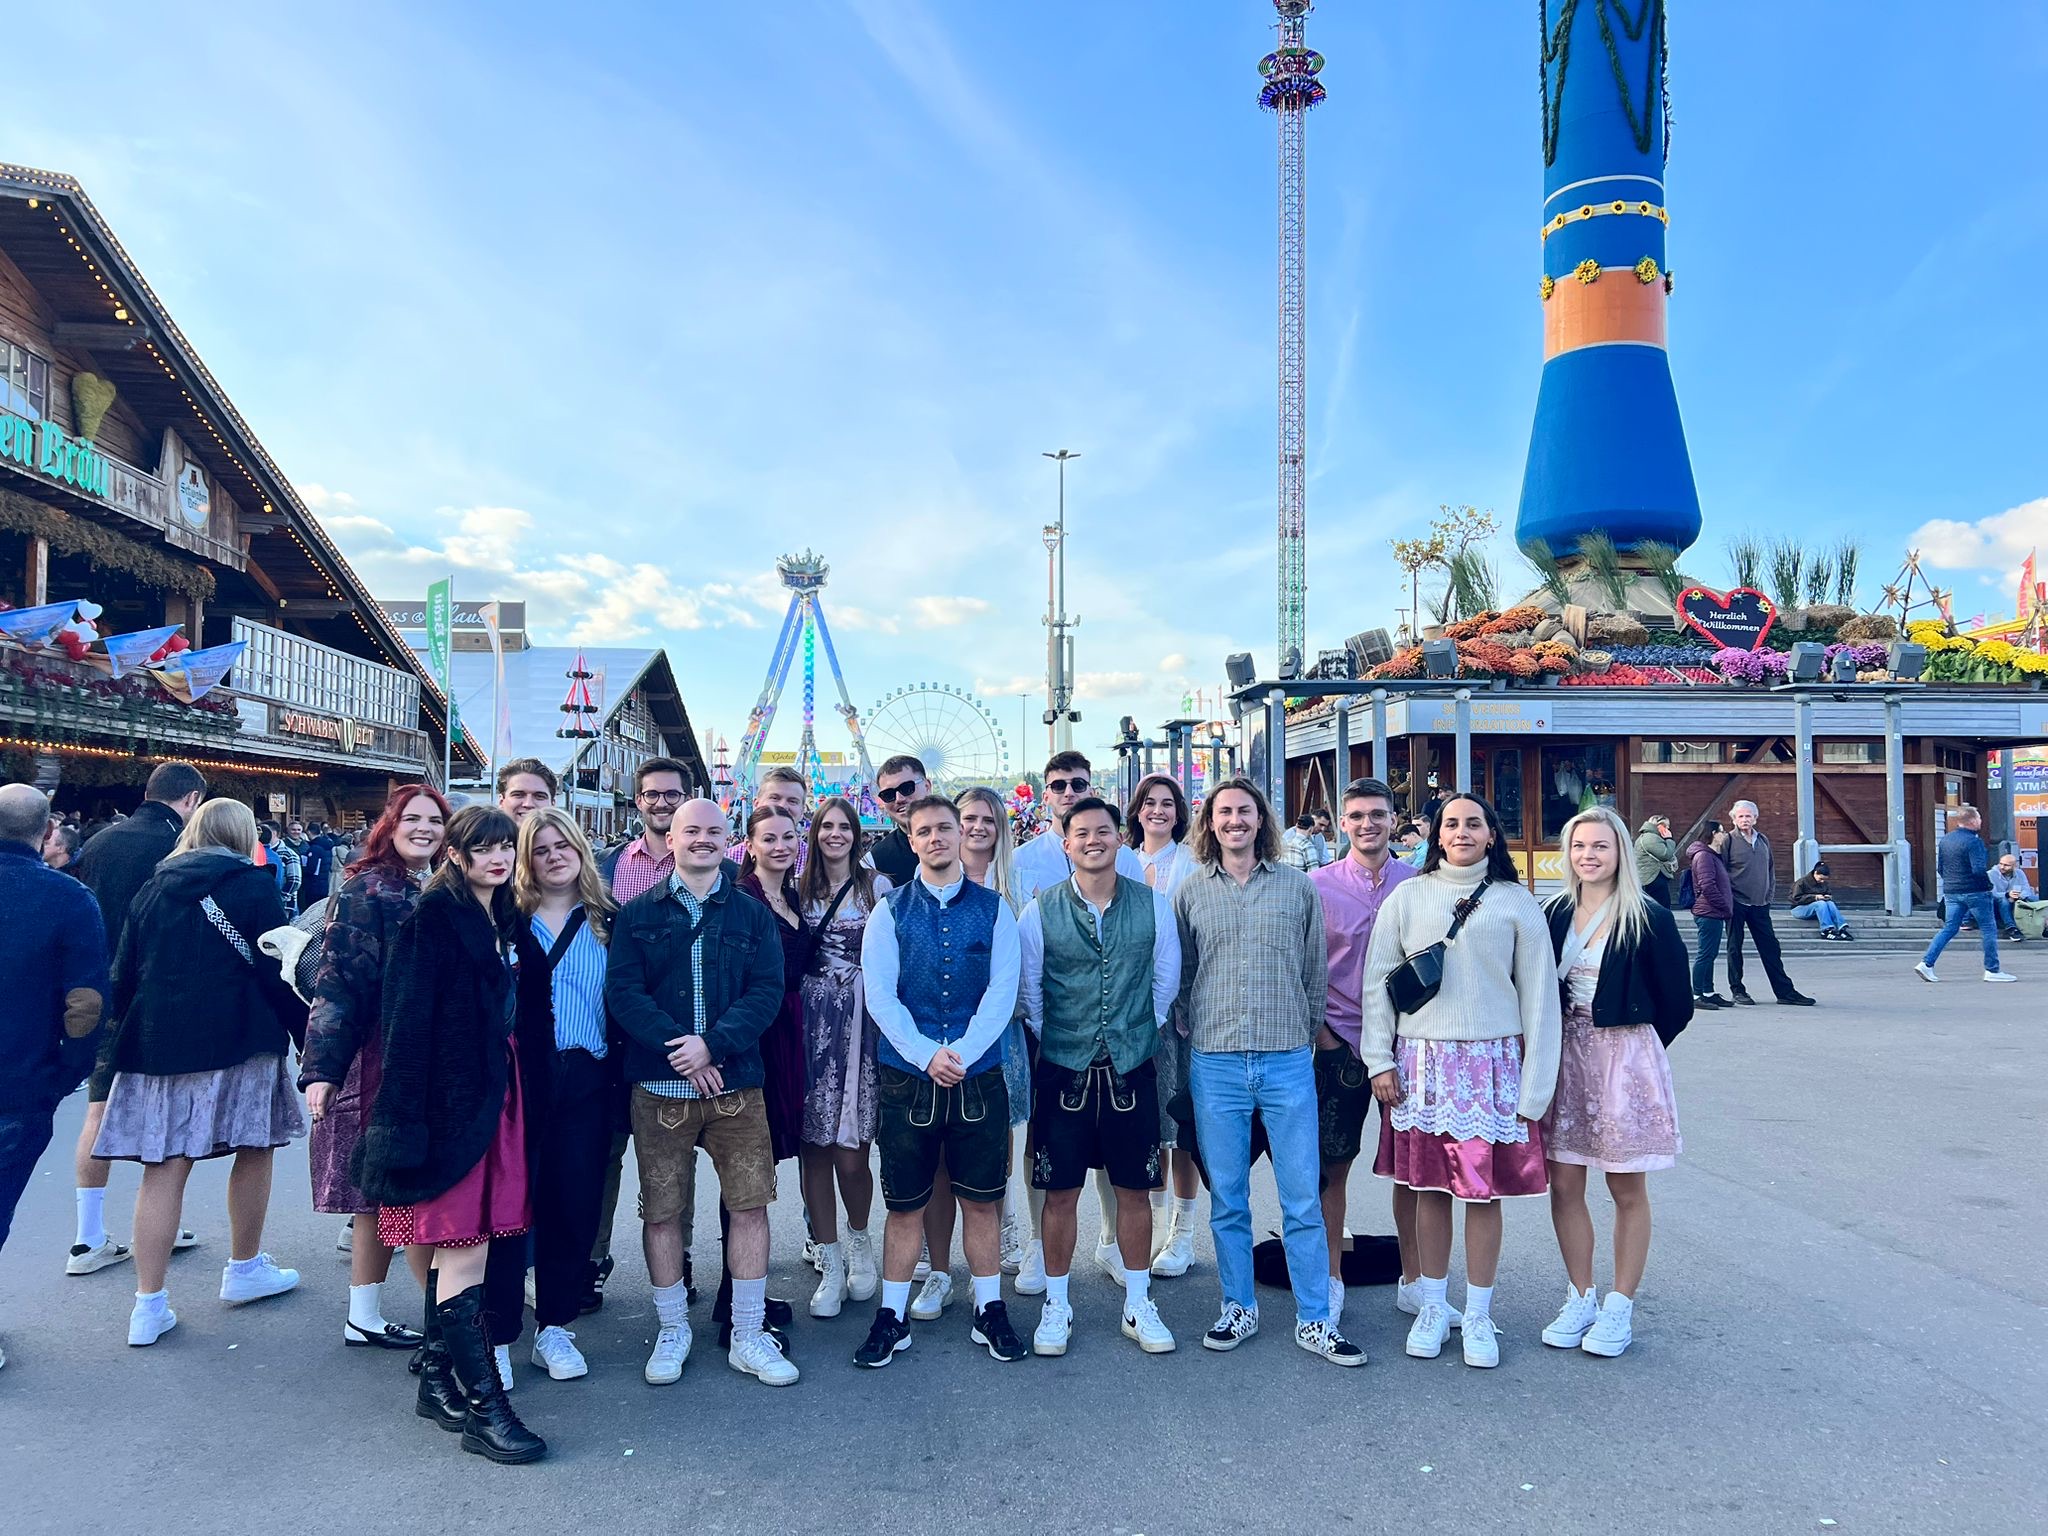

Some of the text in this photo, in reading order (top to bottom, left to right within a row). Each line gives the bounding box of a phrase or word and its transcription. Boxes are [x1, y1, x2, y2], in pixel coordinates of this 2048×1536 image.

[40, 420, 109, 497] Bräu
[1709, 611, 1748, 621] Herzlich
[1702, 620, 1760, 632] Willkommen
[1441, 703, 1520, 715] SOVENIRS
[1432, 719, 1531, 731] INFRMATION
